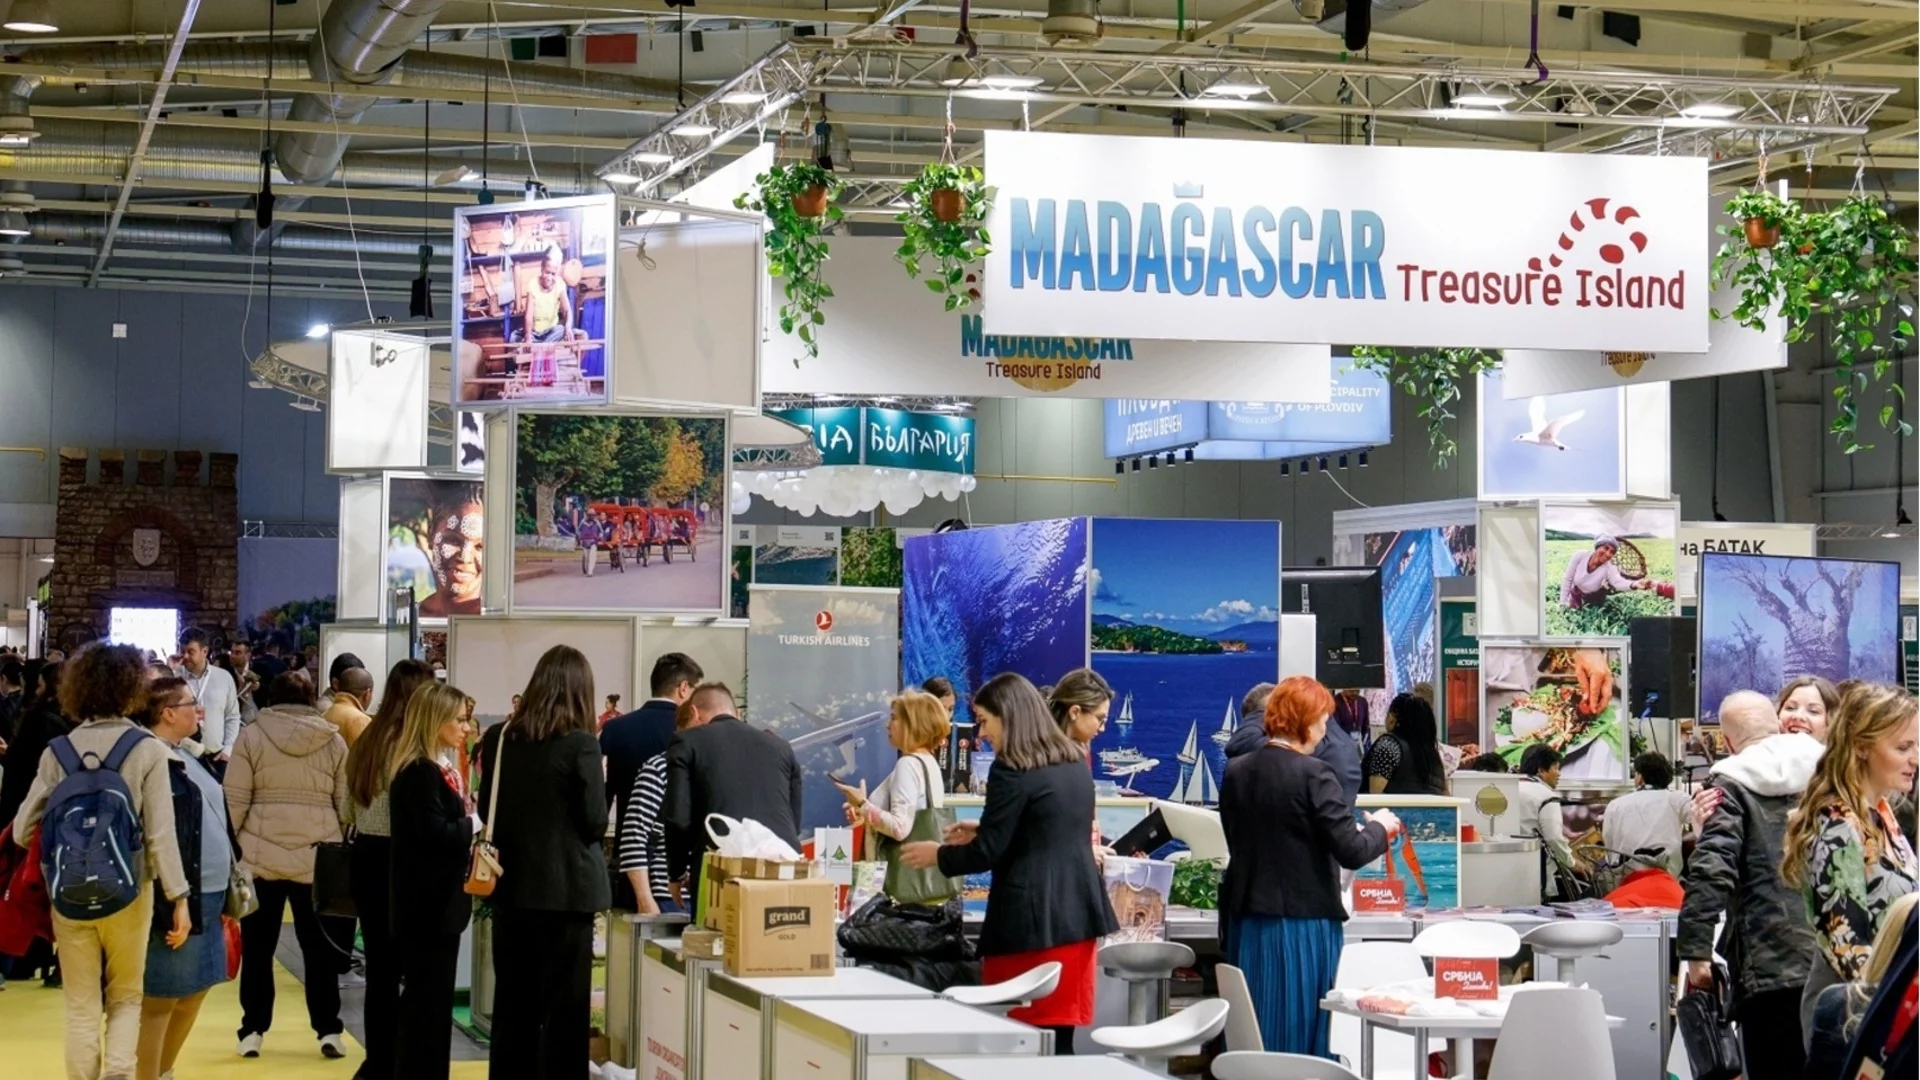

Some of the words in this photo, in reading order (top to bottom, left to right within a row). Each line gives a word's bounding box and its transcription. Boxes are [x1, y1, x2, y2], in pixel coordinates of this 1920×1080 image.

[1010, 198, 1387, 300] MADAGASCAR
[1397, 264, 1563, 306] Treasure
[1576, 267, 1685, 310] Island
[986, 362, 1051, 379] Treasure
[1056, 363, 1101, 380] Island
[1331, 387, 1380, 397] CIPALITY
[1315, 402, 1364, 413] PLOVDIV
[870, 422, 970, 462] БЪЛГАРИЯ
[1704, 539, 1765, 554] БАТАК
[778, 634, 821, 646] TURKISH
[824, 635, 870, 647] AIRLINES
[768, 909, 806, 924] grand
[1442, 971, 1484, 982] СРБИЈА
